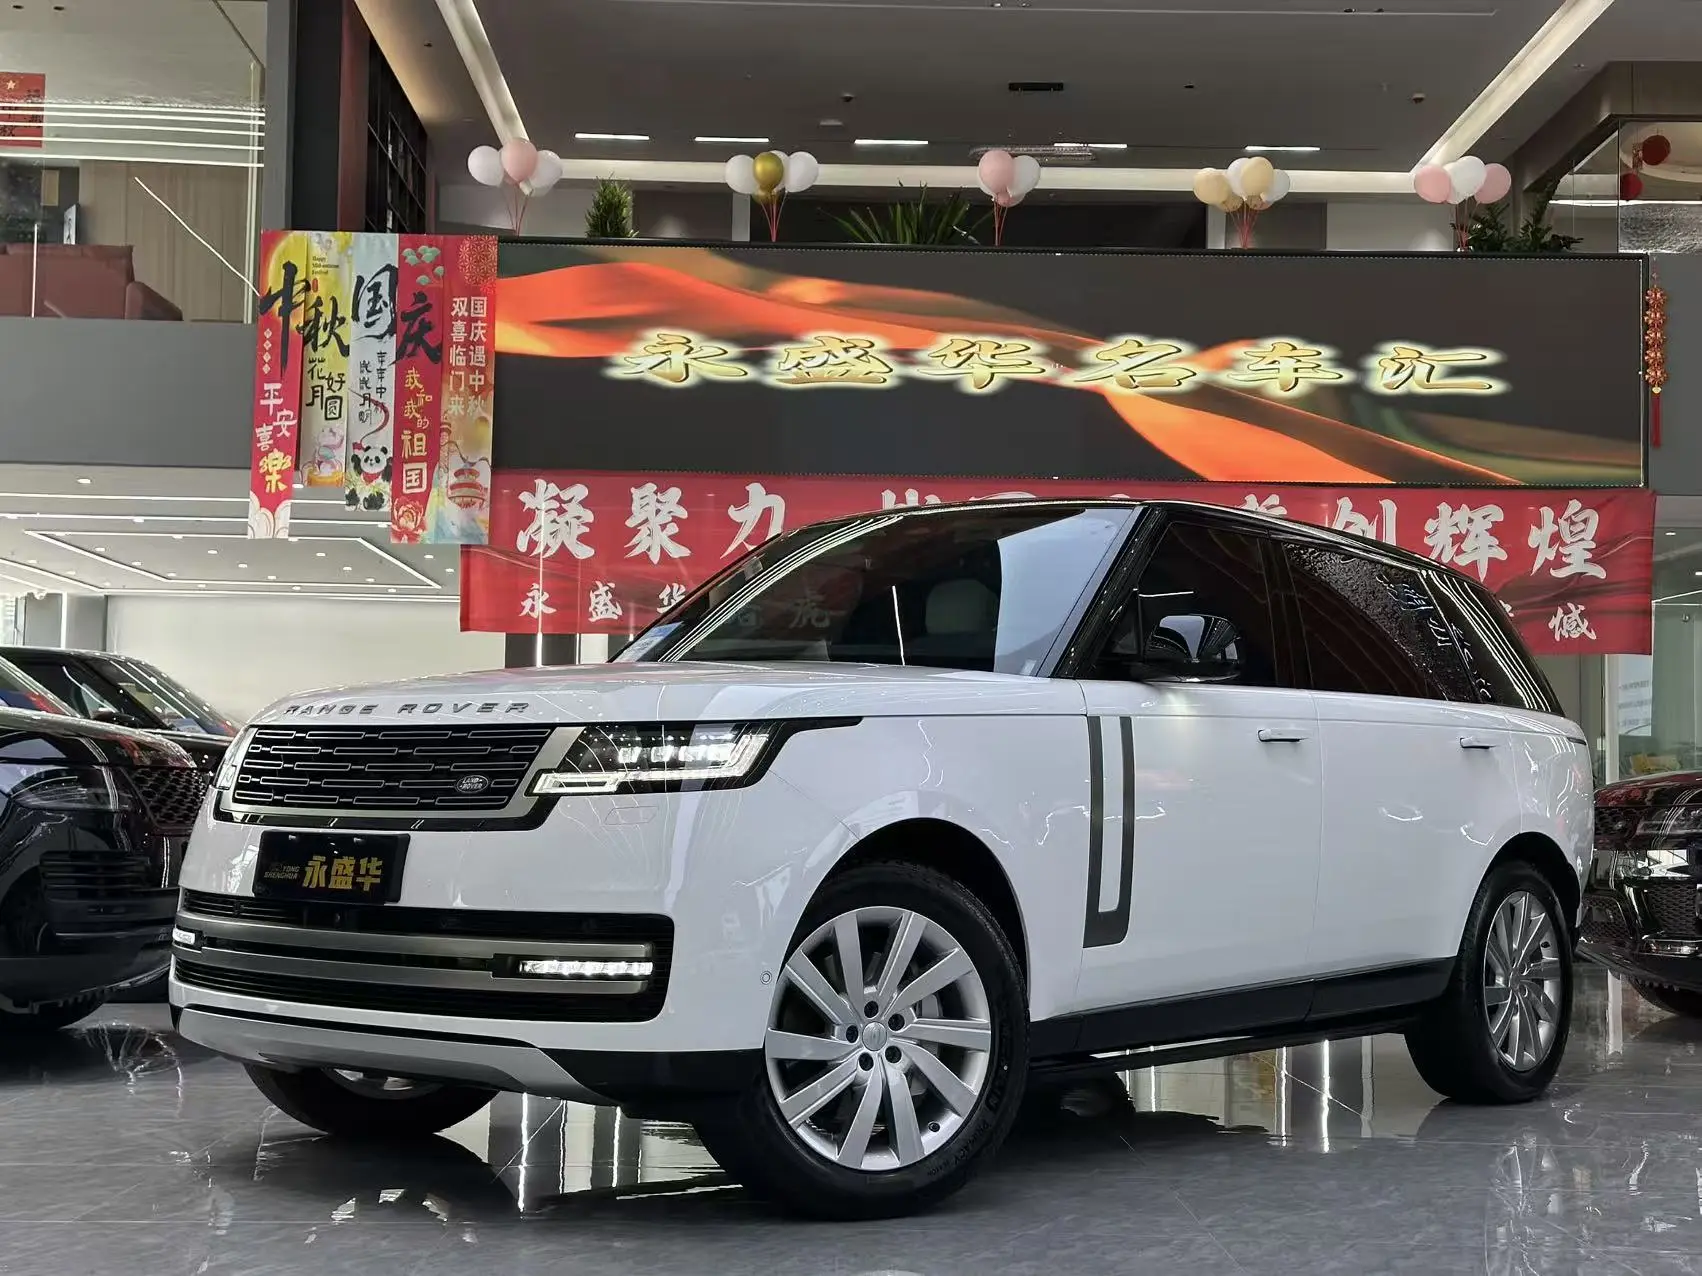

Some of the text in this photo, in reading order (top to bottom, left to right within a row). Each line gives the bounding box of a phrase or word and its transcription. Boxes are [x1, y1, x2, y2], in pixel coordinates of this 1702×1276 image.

[449, 297, 468, 416] 双喜临门来
[468, 297, 488, 415] 国庆遇中秋
[622, 333, 1494, 392] 永盛华名车汇
[516, 478, 786, 564] 凝聚力
[283, 702, 530, 715] RANGE ROVER
[302, 855, 383, 891] 永盛华
